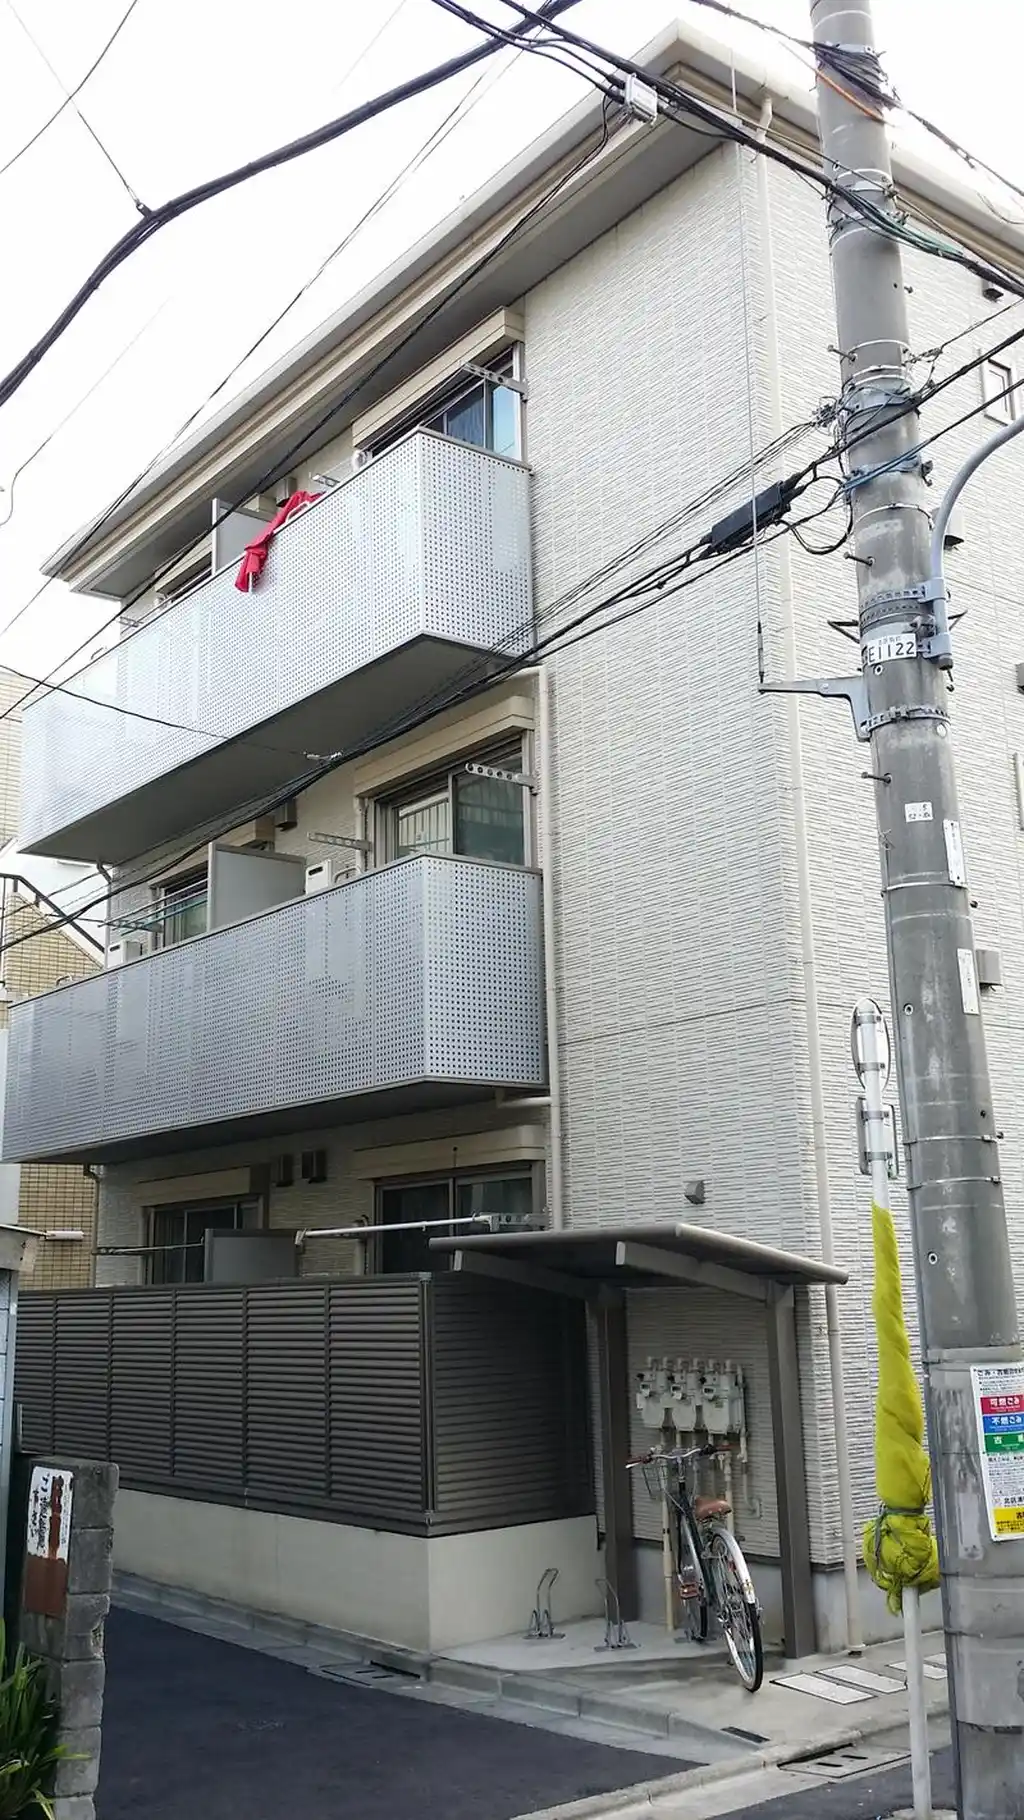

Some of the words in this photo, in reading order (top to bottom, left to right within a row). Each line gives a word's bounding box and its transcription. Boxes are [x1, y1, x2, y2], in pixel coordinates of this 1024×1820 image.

[868, 641, 914, 663] E1122
[990, 1396, 1020, 1407] 可燃ごみ
[991, 1415, 1022, 1426] 不燃ごみ
